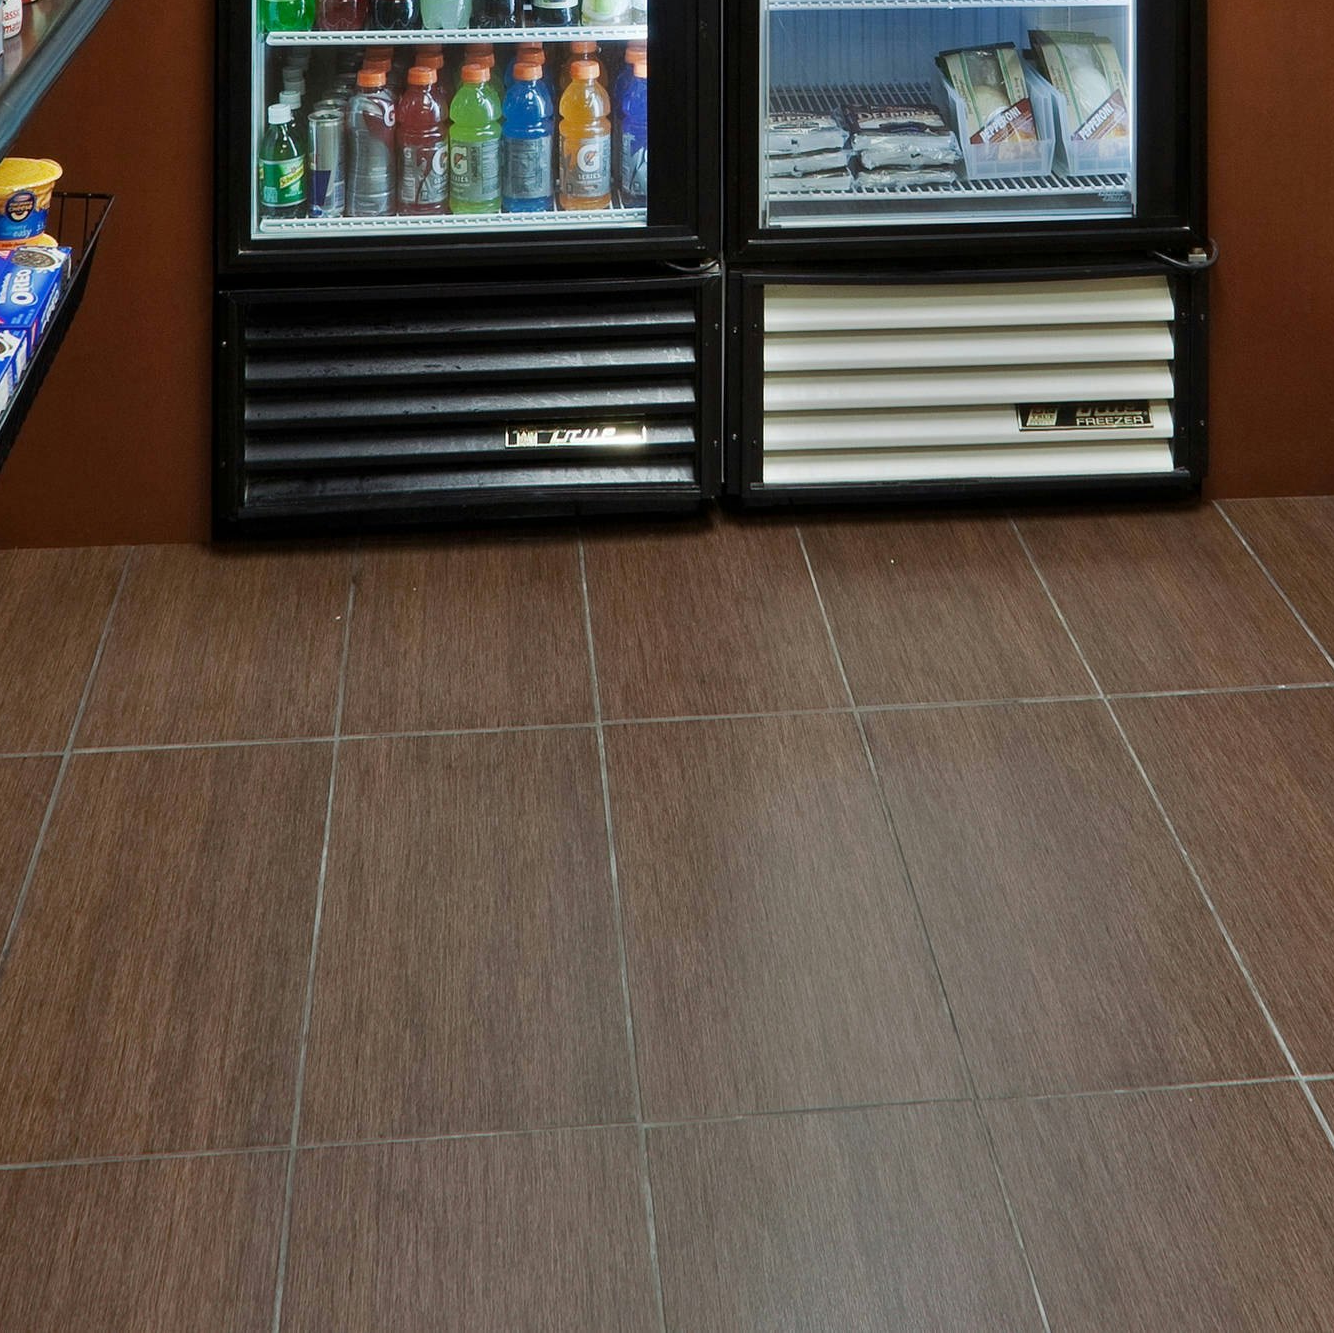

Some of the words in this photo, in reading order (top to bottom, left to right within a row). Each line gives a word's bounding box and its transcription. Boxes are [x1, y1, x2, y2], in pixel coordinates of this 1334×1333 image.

[980, 105, 1022, 142] PEPPERONI
[1078, 100, 1114, 141] PEPPERONI
[577, 144, 601, 173] G
[15, 268, 38, 306] OREO
[1075, 415, 1145, 427] FREEZER
